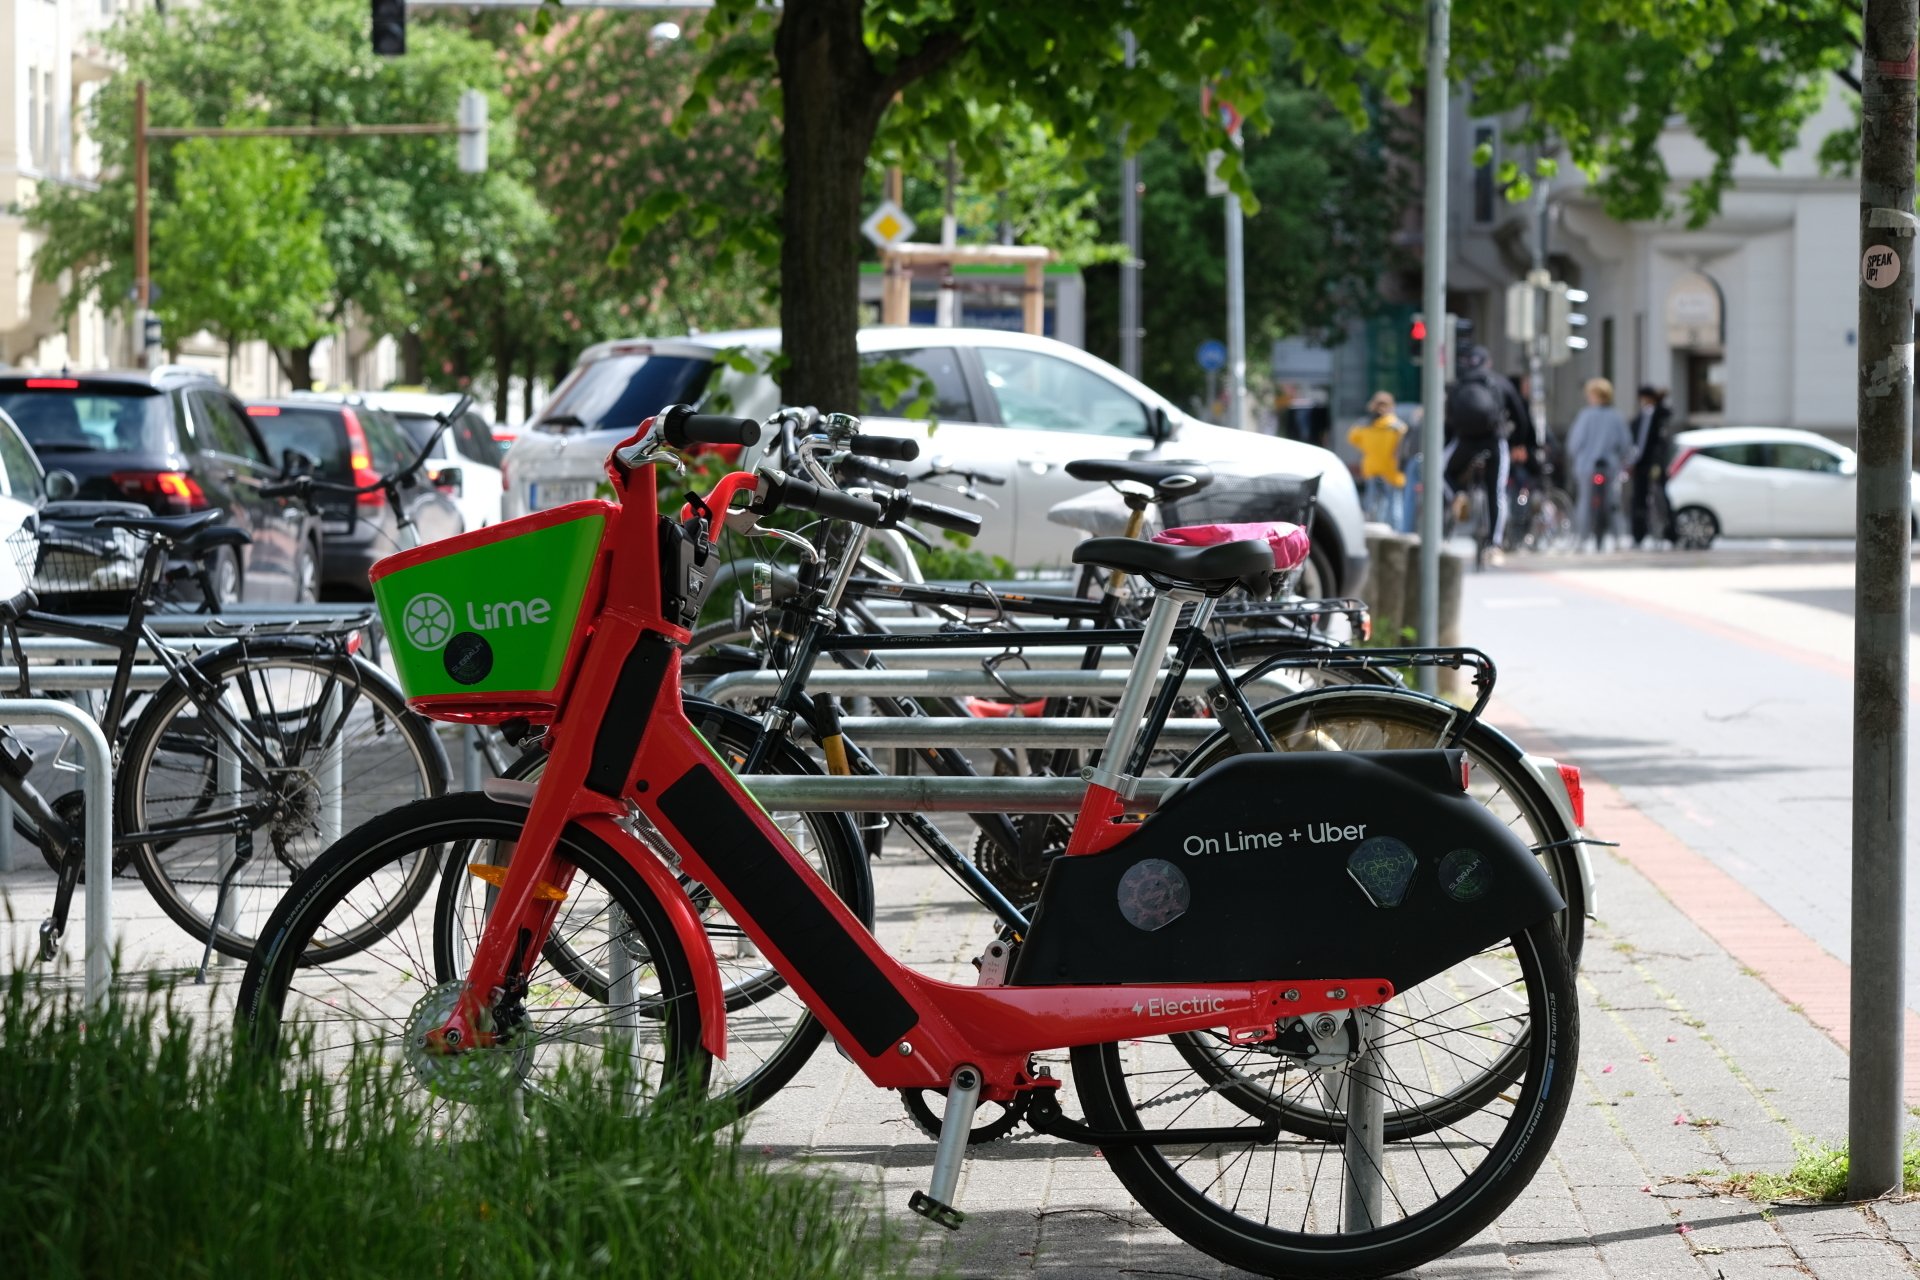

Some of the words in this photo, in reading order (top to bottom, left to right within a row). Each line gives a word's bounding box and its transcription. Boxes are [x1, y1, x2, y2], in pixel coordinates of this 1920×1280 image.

[1866, 268, 1878, 281] UP!
[1867, 252, 1893, 267] SPEAK
[467, 597, 550, 630] Lime
[1183, 834, 1220, 856] On
[1224, 830, 1283, 853] Lime
[1289, 828, 1302, 843] +
[1307, 822, 1367, 845] Uber
[285, 873, 328, 926] MARATHON
[1148, 995, 1225, 1018] Electric
[1549, 992, 1557, 1055] SCHWALBE
[1512, 1101, 1544, 1162] MARATHON
